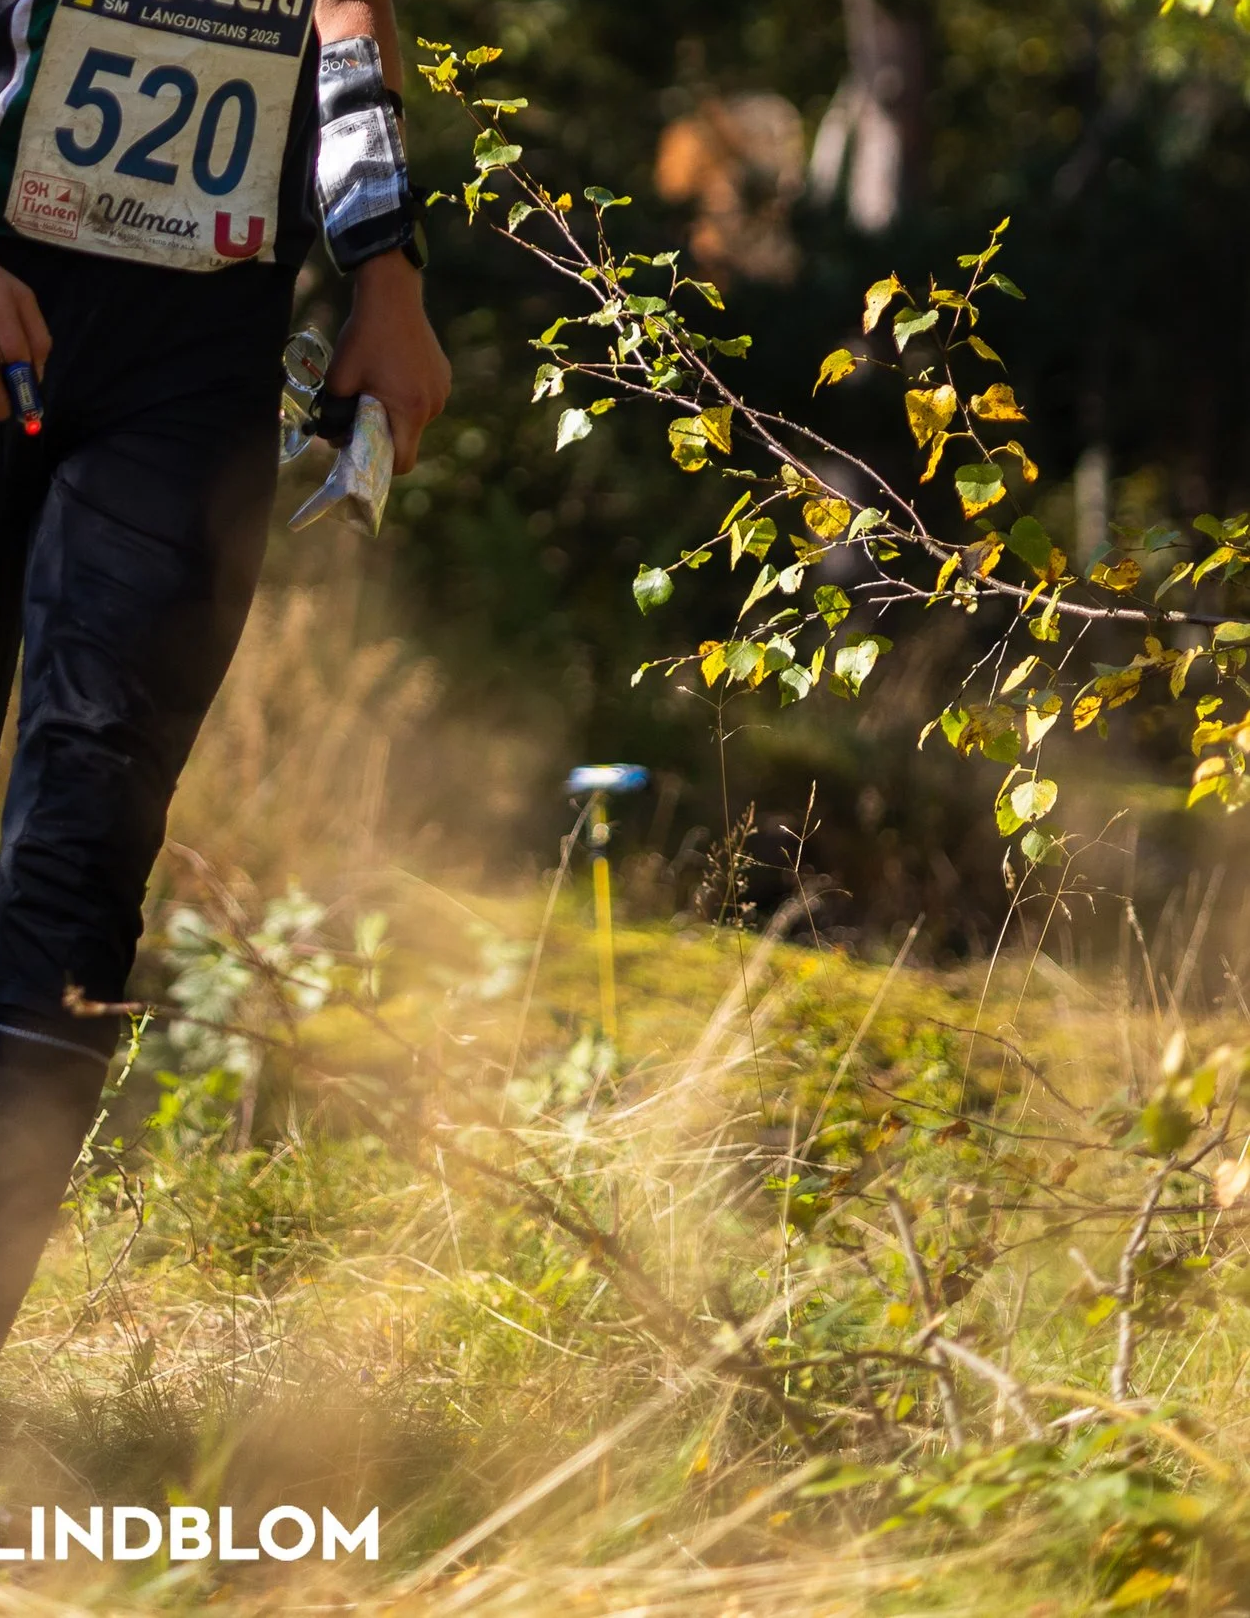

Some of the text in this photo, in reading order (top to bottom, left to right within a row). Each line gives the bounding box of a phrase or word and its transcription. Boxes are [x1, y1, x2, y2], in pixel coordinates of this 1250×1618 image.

[140, 5, 248, 41] LÅNGDISTANS
[249, 28, 281, 47] 2025
[54, 46, 259, 197] 520
[22, 196, 77, 222] Tisaren
[97, 192, 199, 239] Ullmax
